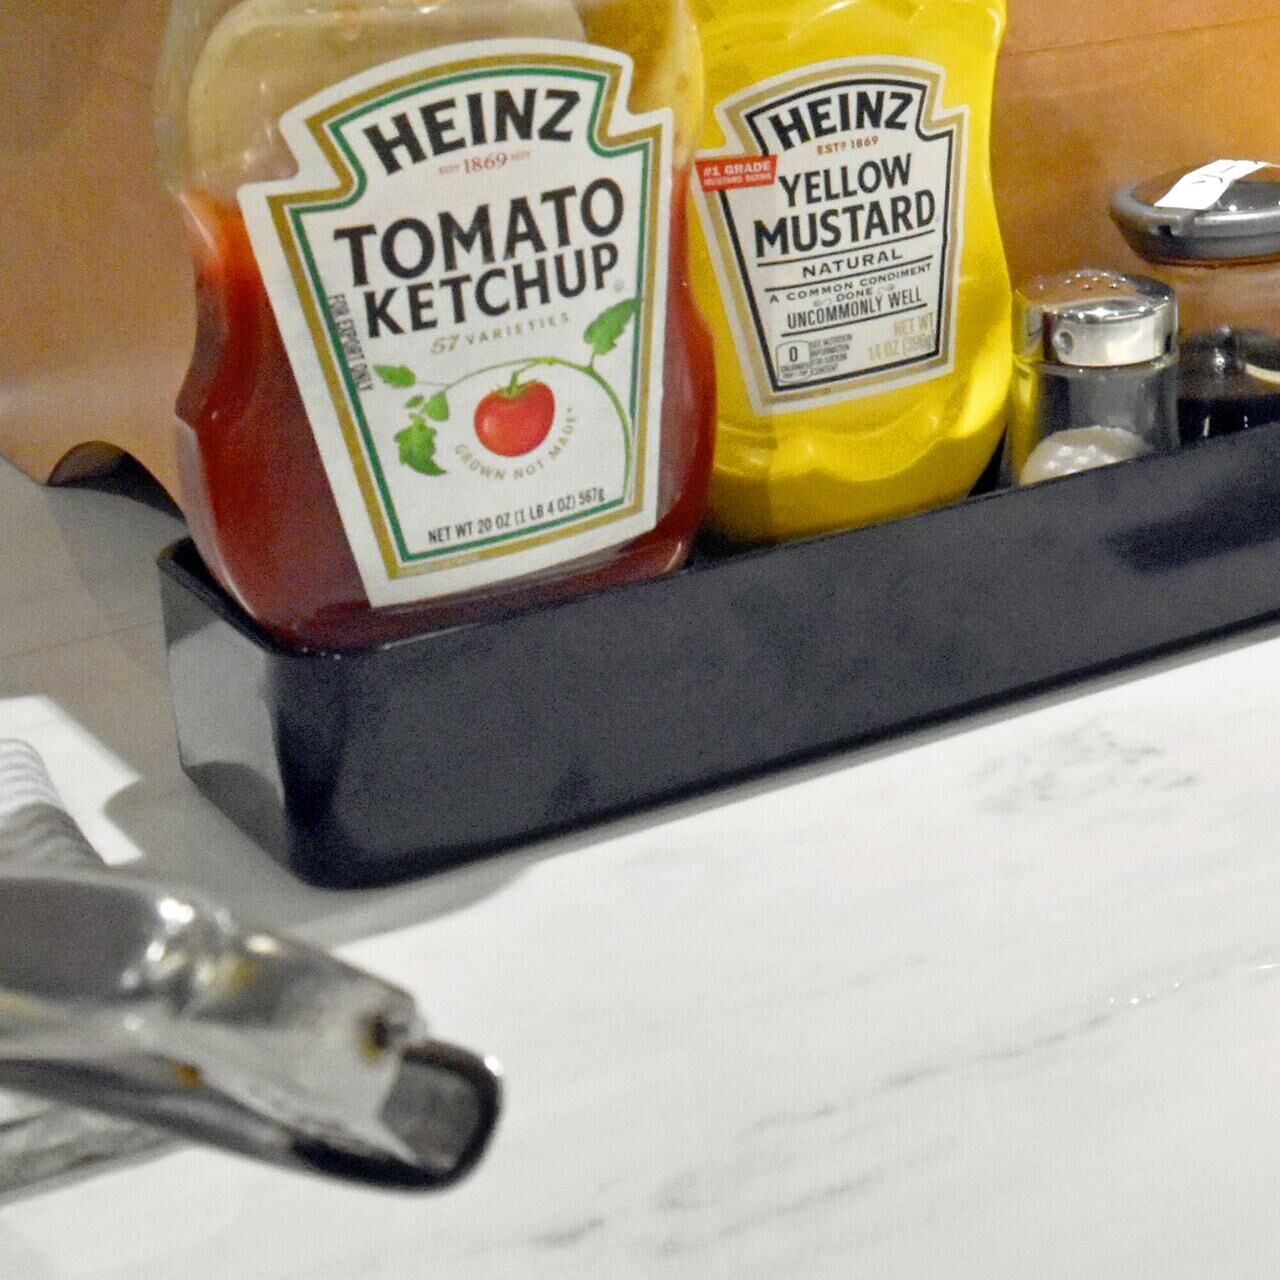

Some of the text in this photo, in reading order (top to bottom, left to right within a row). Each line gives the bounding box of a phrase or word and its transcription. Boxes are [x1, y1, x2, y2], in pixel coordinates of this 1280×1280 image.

[363, 88, 580, 175] HEINZ
[768, 91, 913, 151] HEINZ
[463, 152, 508, 175] 1869
[851, 135, 879, 150] 1869
[724, 160, 771, 175] GRADE
[778, 152, 912, 208] YELLOW
[333, 177, 624, 287] TOMATO
[754, 189, 936, 258] MUSTARD
[769, 262, 933, 304] A COMMON CONDIMENT
[802, 248, 903, 278] NATURAL
[364, 241, 619, 338] KETCHUP
[787, 286, 922, 329] UNCOMMONLY WELL
[836, 287, 874, 302] DONE
[431, 312, 569, 354] 57 VARIETIES
[788, 346, 798, 362] 0
[455, 444, 505, 480] GROWN
[513, 460, 544, 480] NOT
[428, 526, 451, 544] NET
[455, 521, 473, 539] WT
[477, 517, 492, 535] 20
[495, 512, 511, 528] OZ
[529, 504, 544, 521] LB
[547, 502, 554, 515] 4
[557, 495, 576, 513] OZ)
[578, 488, 606, 506] 567g
